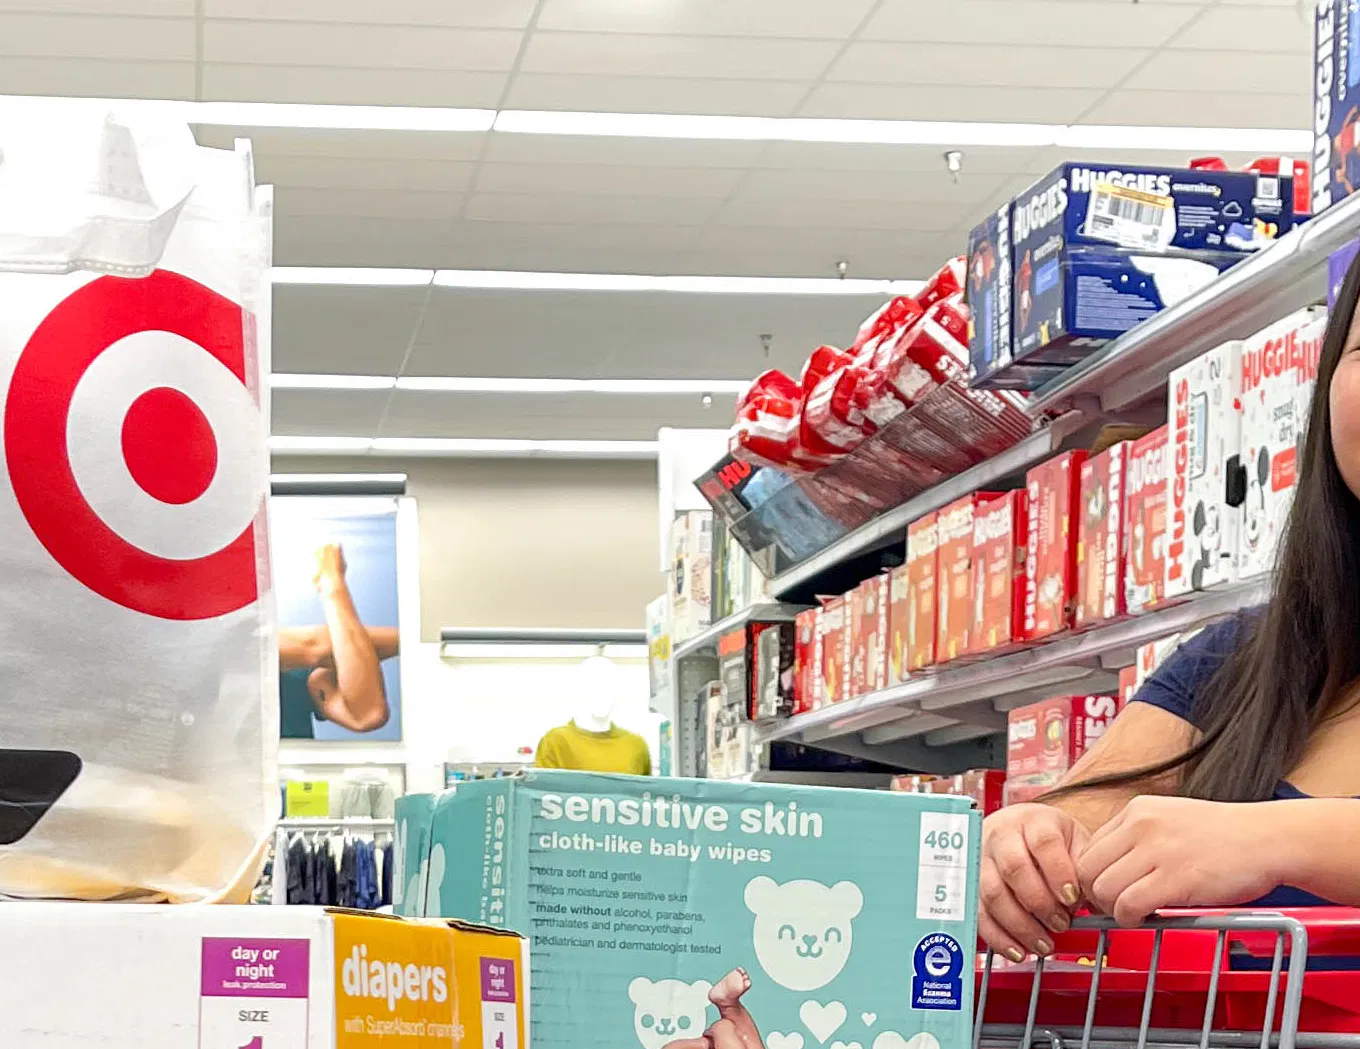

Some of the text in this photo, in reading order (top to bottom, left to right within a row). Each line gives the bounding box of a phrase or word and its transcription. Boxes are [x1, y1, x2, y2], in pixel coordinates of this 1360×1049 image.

[1014, 178, 1068, 245] HUGGIES
[1241, 329, 1298, 393] HUGGIE
[1168, 378, 1190, 581] HUGGIES
[540, 793, 824, 838] sensitive skin
[538, 831, 772, 865] cloth-like baby wipes
[924, 830, 964, 851] 460
[566, 867, 586, 879] soft
[589, 869, 608, 880] and
[611, 870, 642, 883] gentle
[567, 885, 620, 899] moisturize
[621, 888, 666, 901] sensitive
[668, 891, 688, 903] skin
[934, 884, 947, 902] 5
[536, 903, 567, 916] made
[570, 904, 612, 918] without
[656, 910, 706, 923] parabens,
[590, 919, 611, 931] and
[613, 921, 693, 935] phenoxyethanol
[535, 935, 721, 955] pediatrician and dermatologist tested
[921, 935, 958, 952] ACCEPTED
[231, 946, 280, 961] day or
[235, 963, 275, 980] night
[342, 944, 448, 1012] diapers
[923, 981, 951, 989] National
[238, 1010, 269, 1023] SIZE
